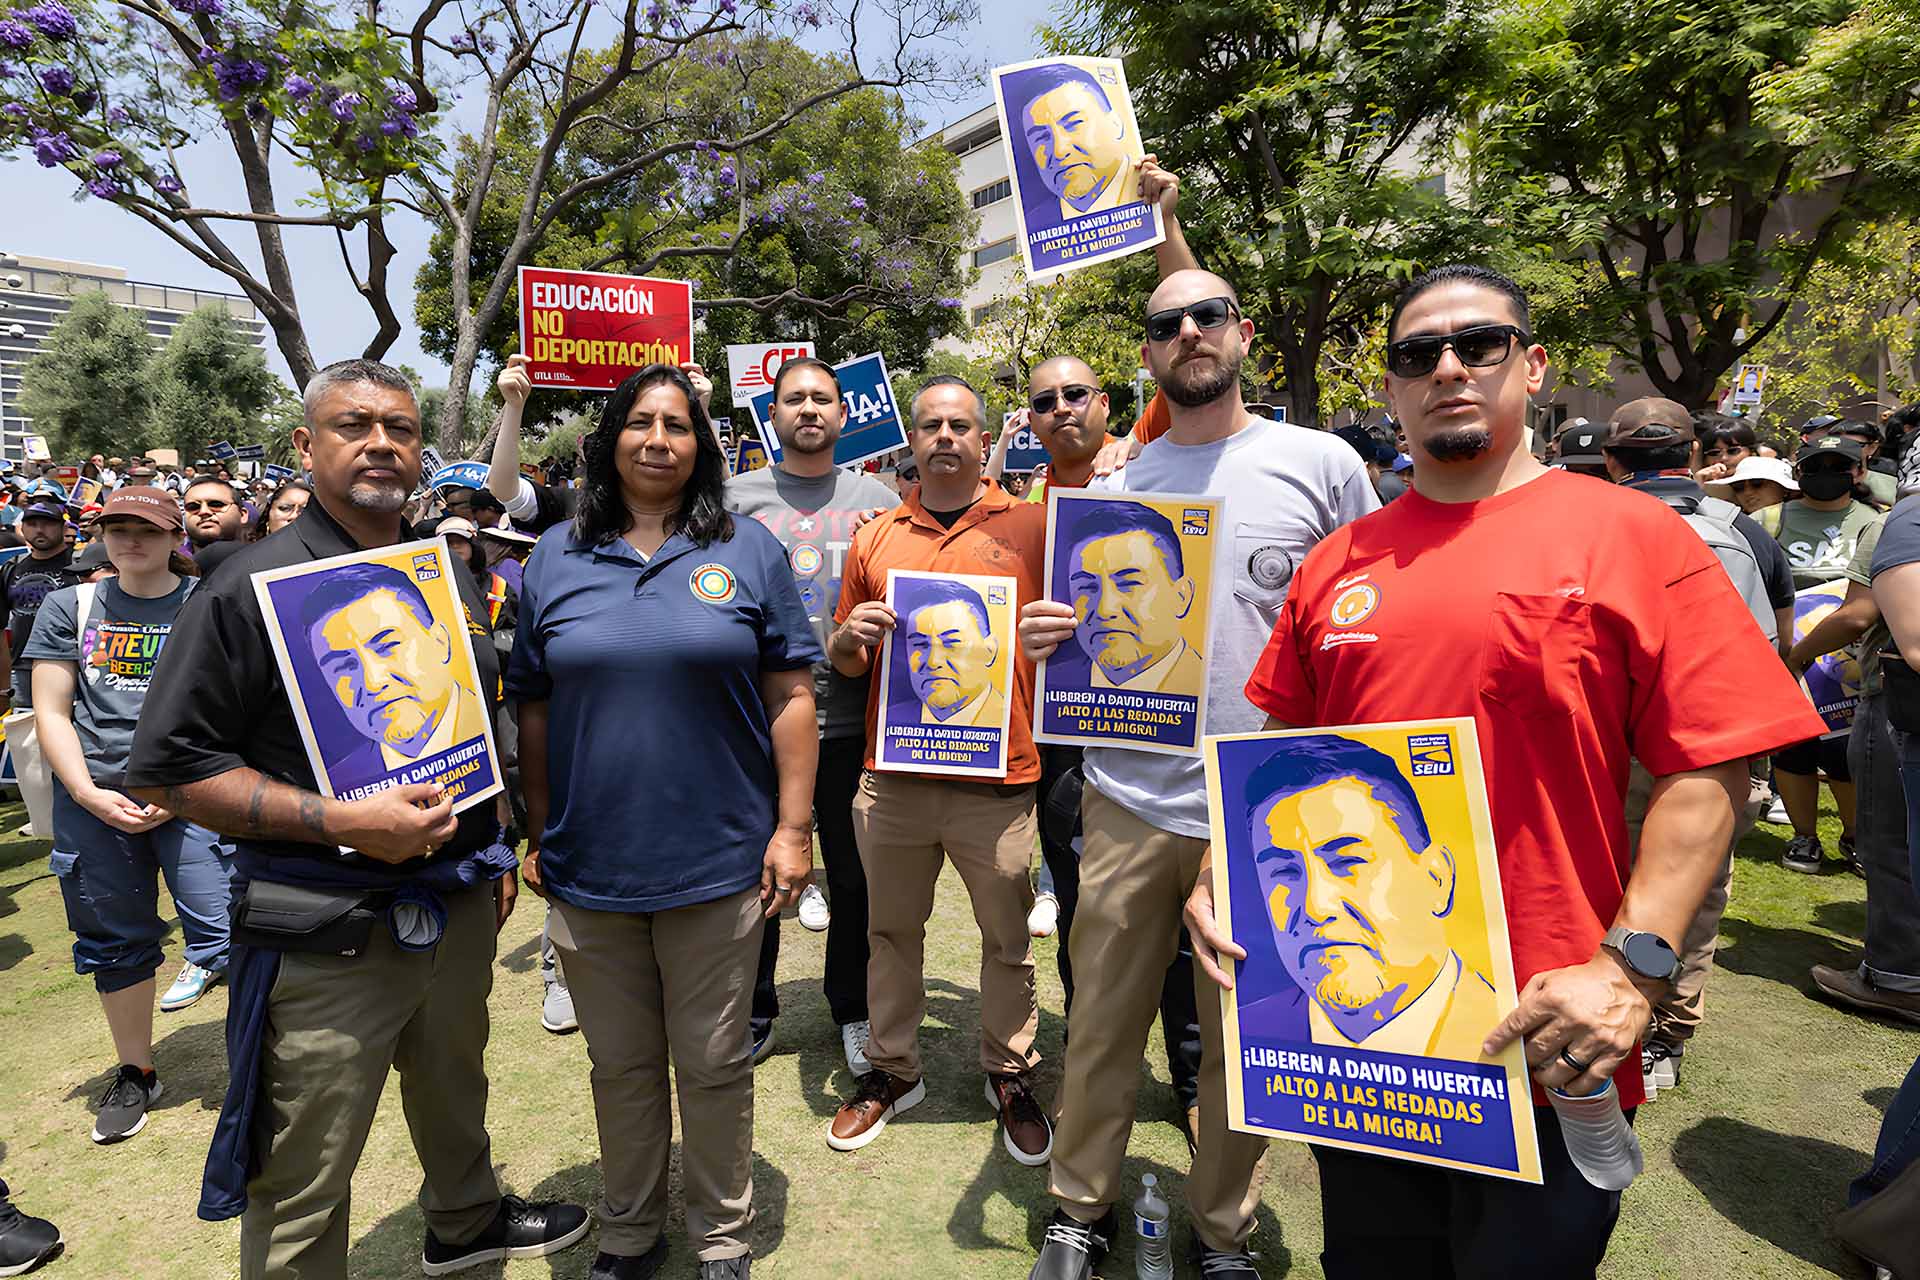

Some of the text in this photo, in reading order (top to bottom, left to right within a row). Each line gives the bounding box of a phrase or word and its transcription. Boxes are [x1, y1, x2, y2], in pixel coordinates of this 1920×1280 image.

[1072, 223, 1079, 233] A
[1080, 215, 1109, 231] DAVID
[1071, 235, 1077, 245] A
[1079, 230, 1096, 242] LAS
[1076, 245, 1088, 255] LA
[532, 282, 653, 315] EDUCACIÓN
[532, 309, 564, 336] NO
[533, 337, 679, 367] DEPORTACIÓN
[843, 383, 891, 424] LA!
[1098, 694, 1106, 705] A
[1108, 694, 1143, 707] DAVID
[1147, 697, 1195, 712] HUERTA!
[1093, 707, 1100, 717] A
[1104, 708, 1124, 719] LAS
[1127, 710, 1182, 725] REDADAS
[926, 728, 933, 737] A
[1079, 720, 1093, 730] DE
[1097, 721, 1110, 732] LA
[922, 739, 928, 748] A
[930, 739, 947, 750] LAS
[401, 773, 410, 786] A
[411, 759, 446, 782] DAVID
[448, 740, 486, 767] HUERTA!
[925, 750, 936, 760] LA
[1414, 762, 1451, 775] SEIU
[1243, 1047, 1505, 1100] ¡LIBEREN A DAVID HUERTA!
[1266, 1074, 1483, 1124] ¡ALTO A LAS REDADAS
[1303, 1104, 1442, 1145] DE LA MIGRA!
